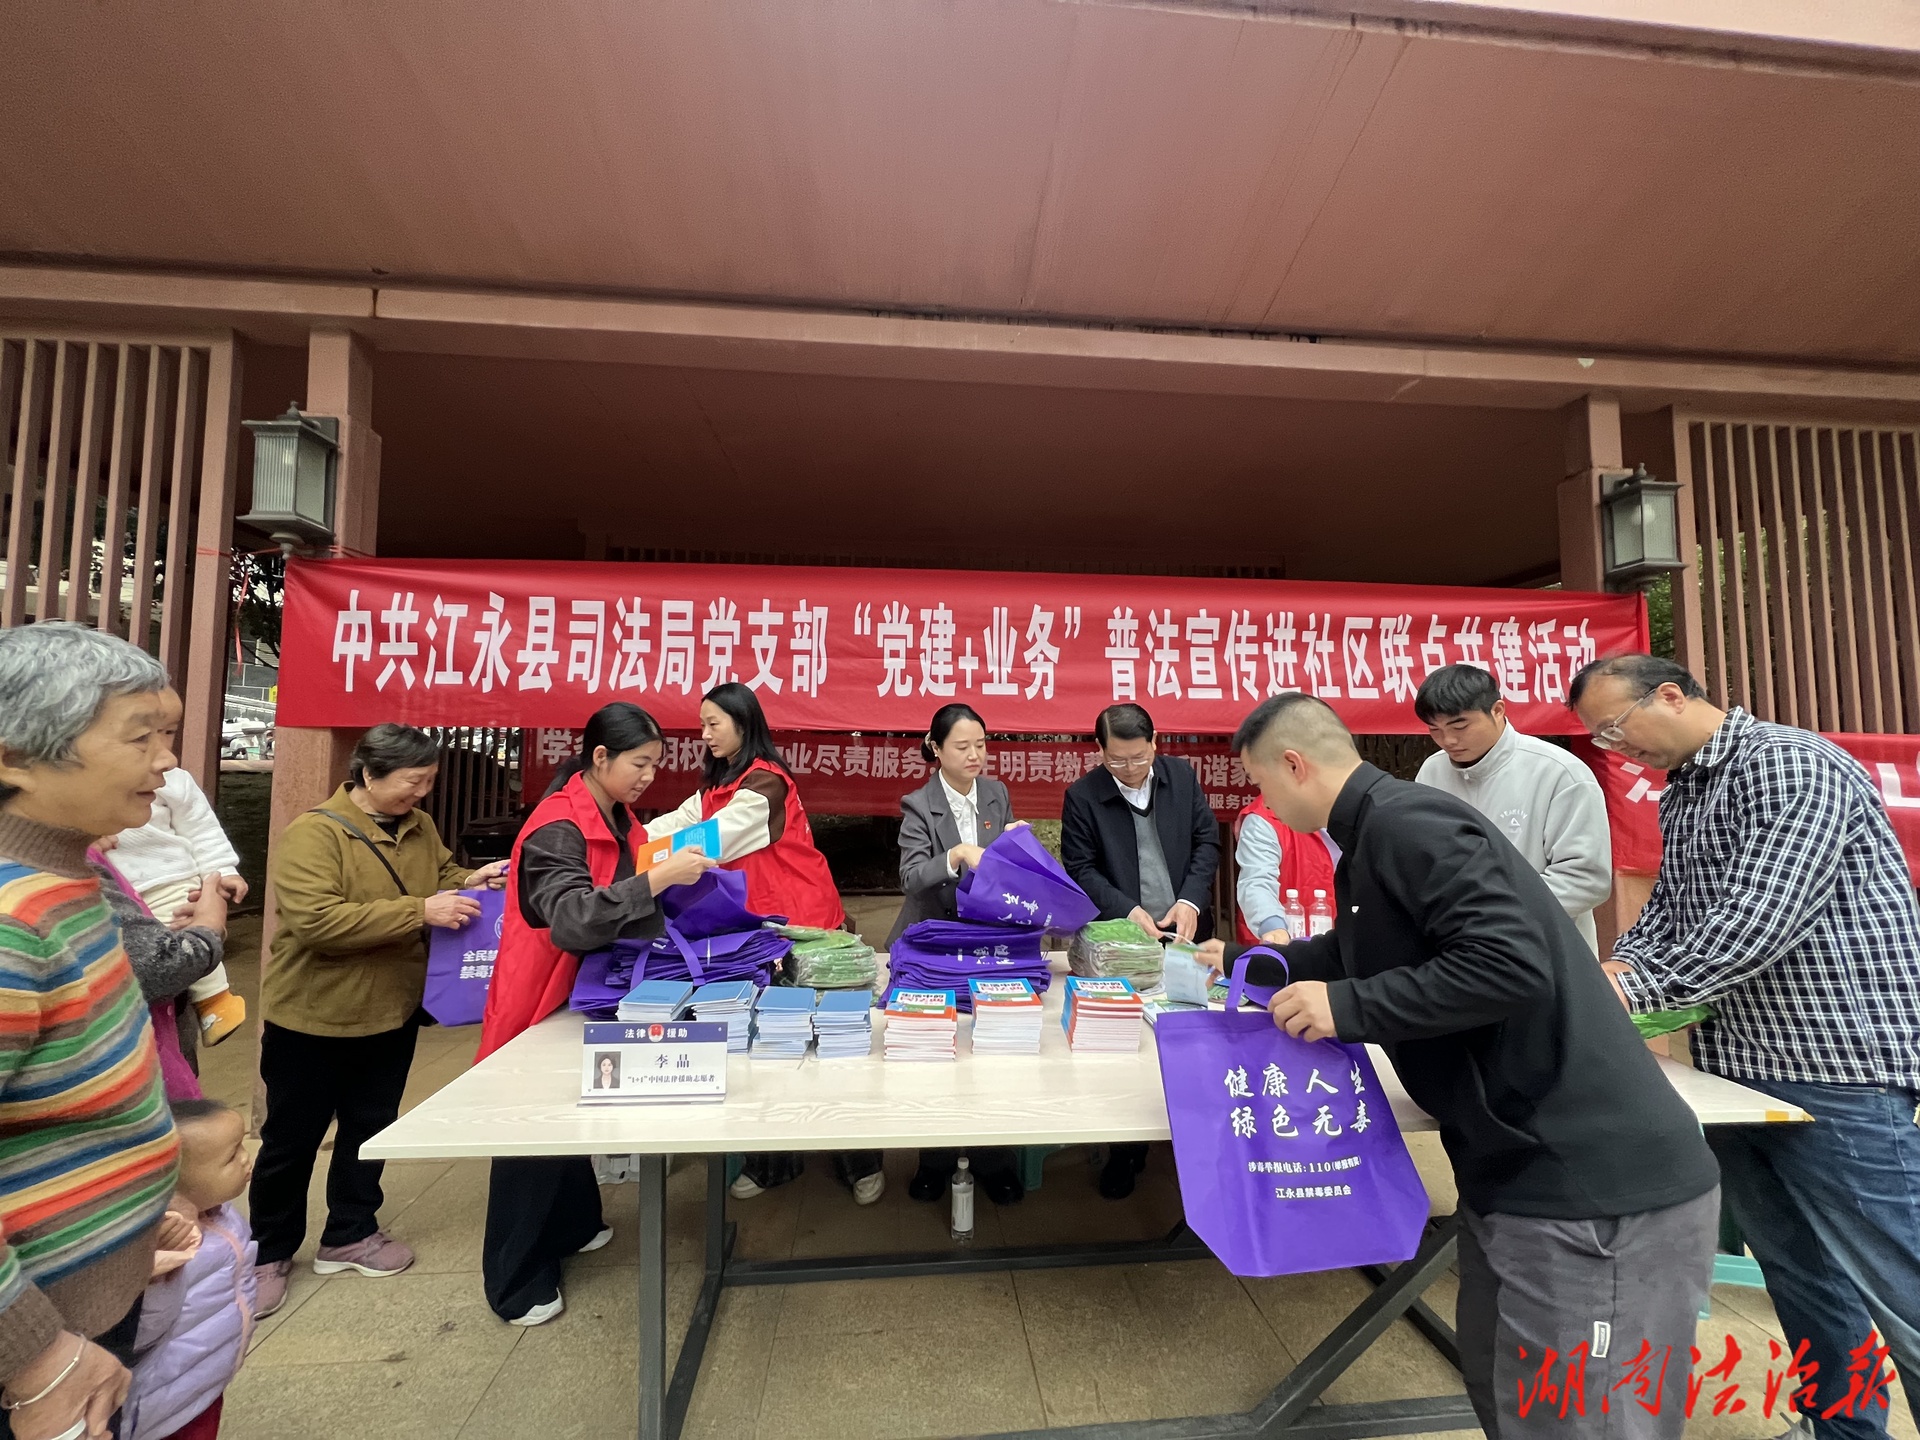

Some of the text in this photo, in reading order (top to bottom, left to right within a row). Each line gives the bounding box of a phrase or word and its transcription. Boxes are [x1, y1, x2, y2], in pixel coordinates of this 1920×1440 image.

[775, 743, 927, 779] 业尽责服务
[462, 949, 498, 962] 全民禁
[459, 965, 494, 979] 禁毒
[625, 1027, 688, 1039] 法律 援助
[1275, 1185, 1352, 1199] 江永县禁毒委员会
